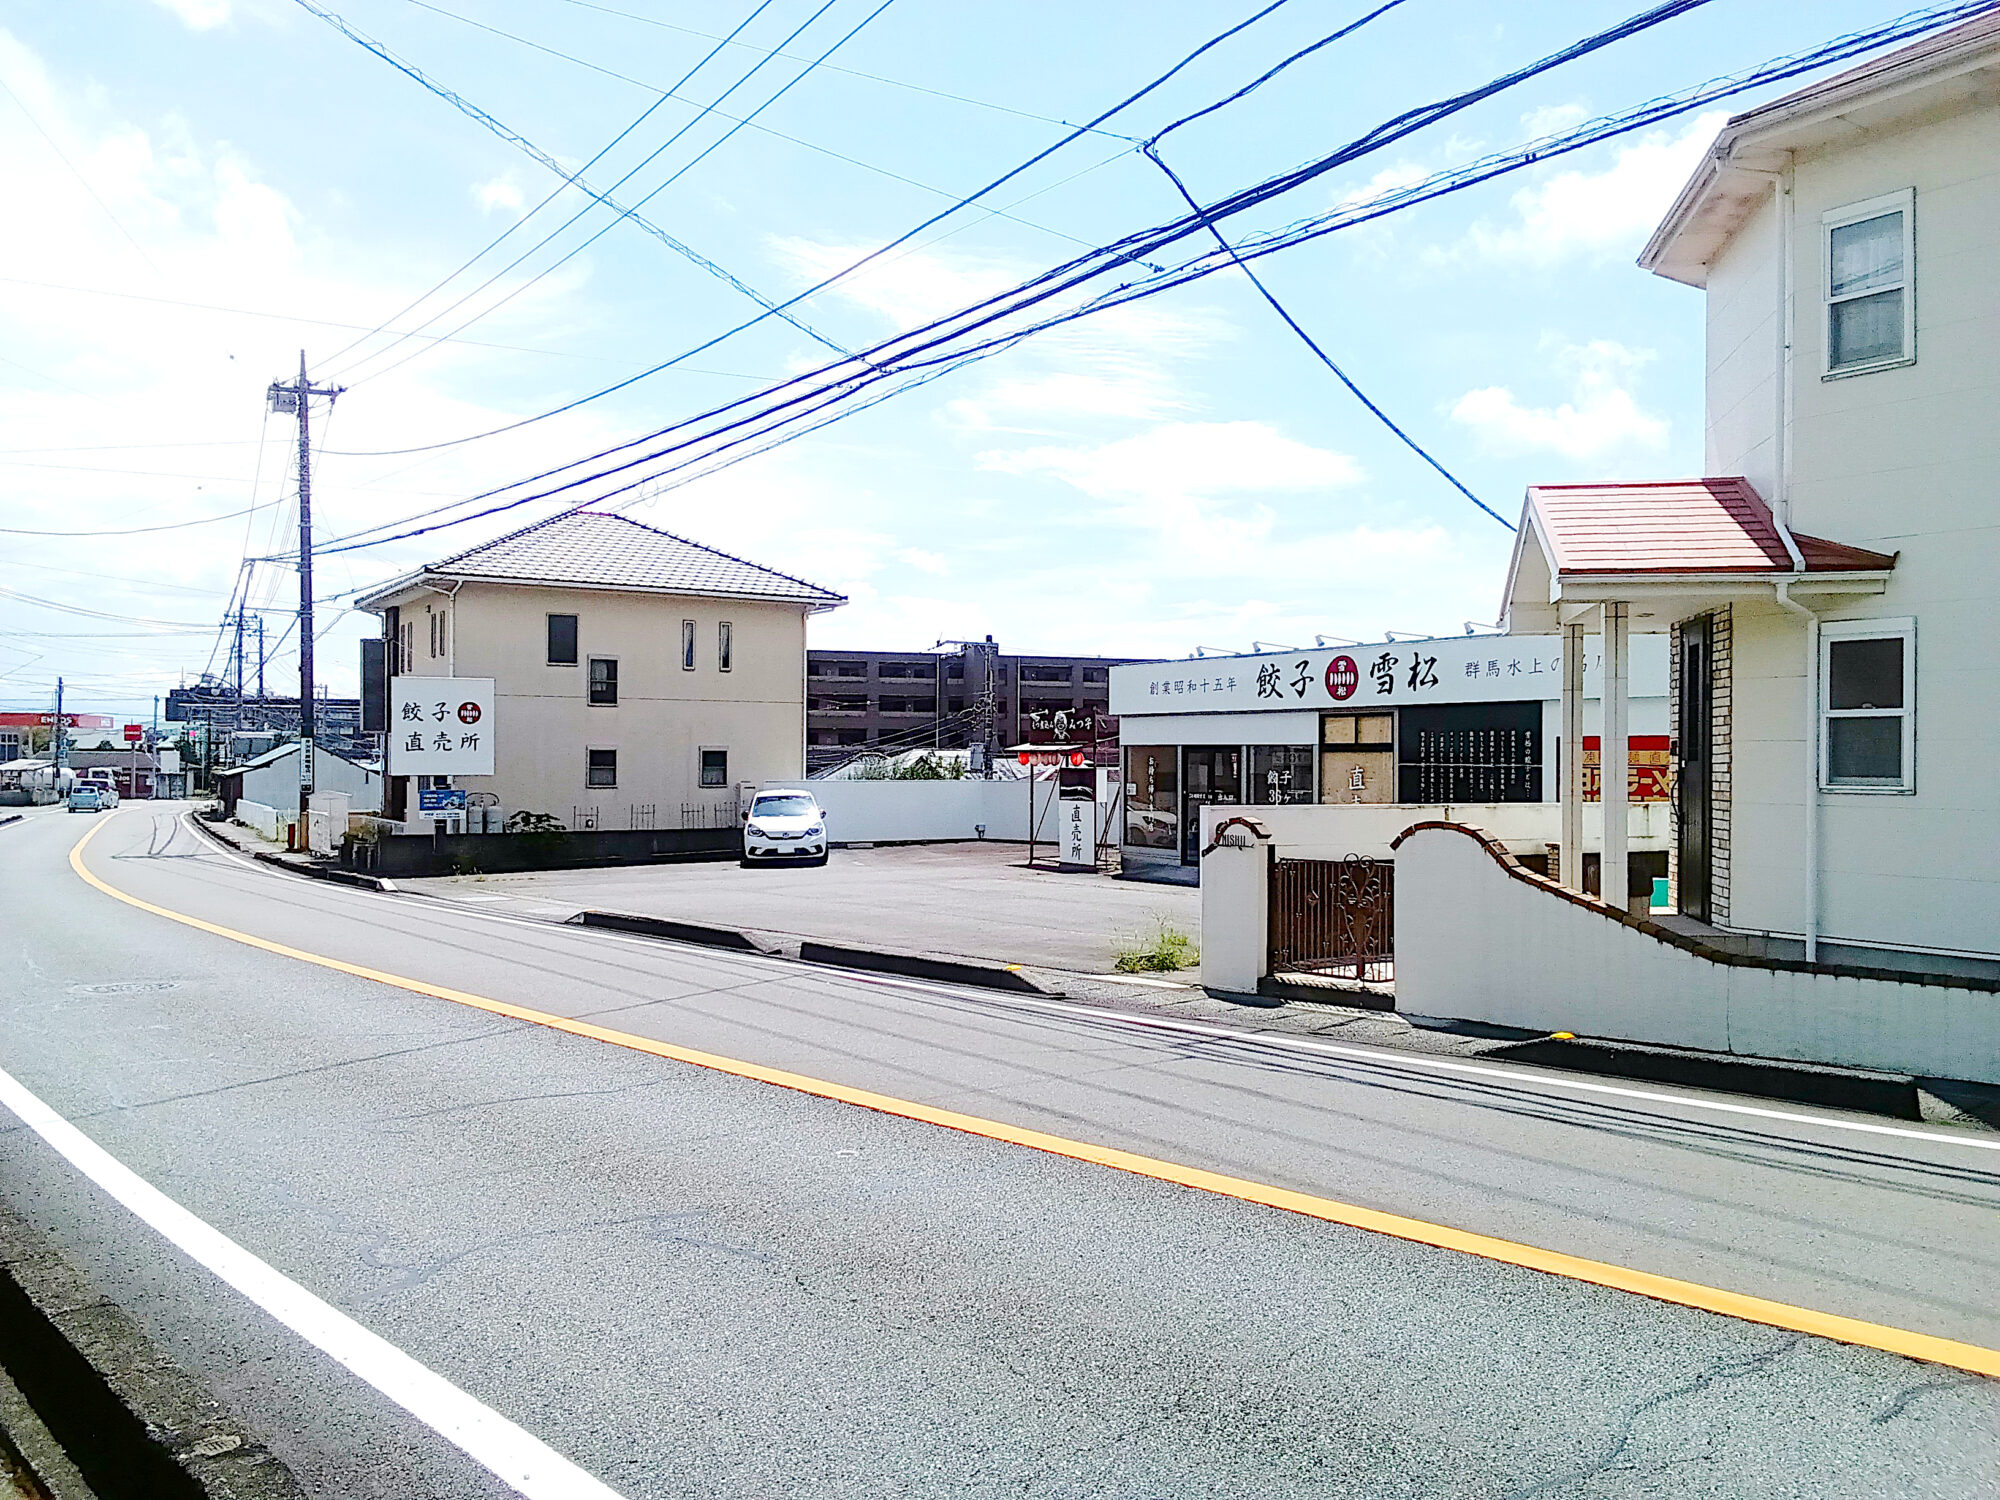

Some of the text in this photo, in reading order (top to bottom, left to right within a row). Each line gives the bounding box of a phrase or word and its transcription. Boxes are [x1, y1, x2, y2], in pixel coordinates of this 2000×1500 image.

[1150, 676, 1237, 695] 創業昭和十五年
[1256, 660, 1315, 699] 餃子
[1370, 652, 1439, 695] 雪松
[41, 716, 72, 725] ENOS
[401, 702, 451, 723] 餃子
[404, 731, 481, 752] 直売所
[1267, 769, 1293, 785] 餃子
[1071, 804, 1082, 860] 直売所
